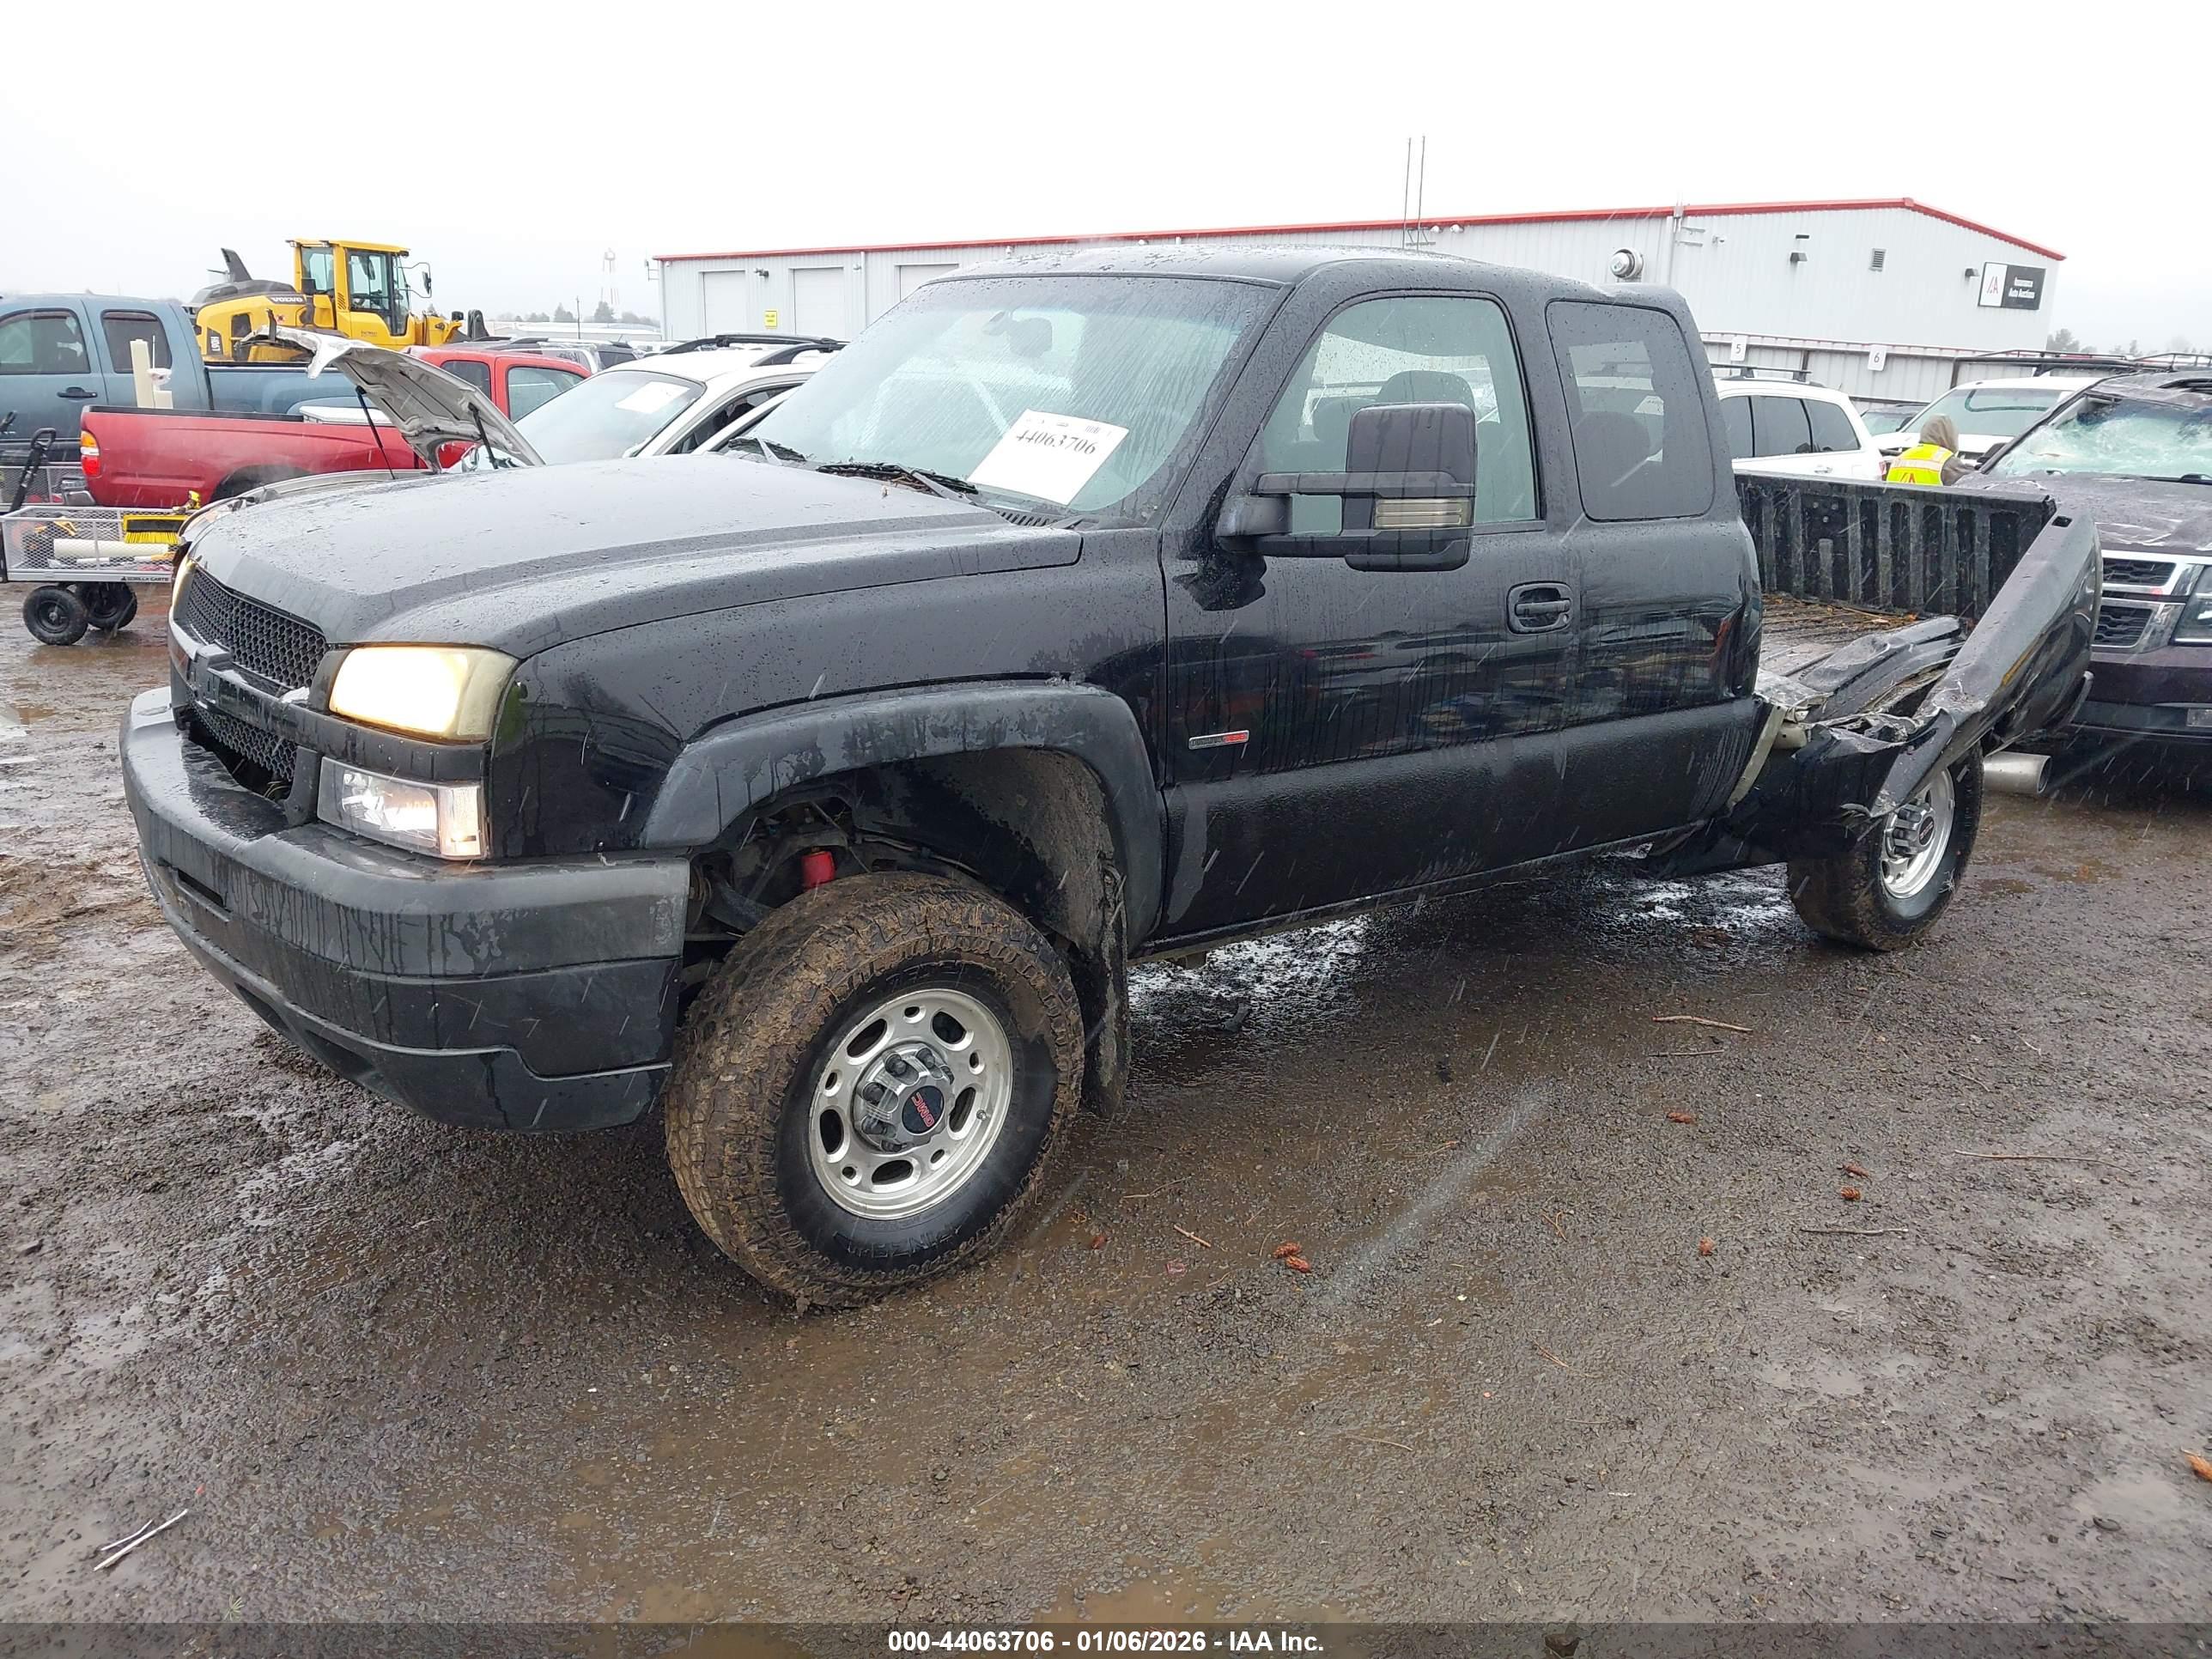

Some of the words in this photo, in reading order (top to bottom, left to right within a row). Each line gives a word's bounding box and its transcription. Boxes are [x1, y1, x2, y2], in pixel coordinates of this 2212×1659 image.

[1735, 343, 1741, 354] 5
[1874, 352, 1880, 363] 6
[1016, 429, 1098, 454] 44063706
[910, 1091, 935, 1127] GMC
